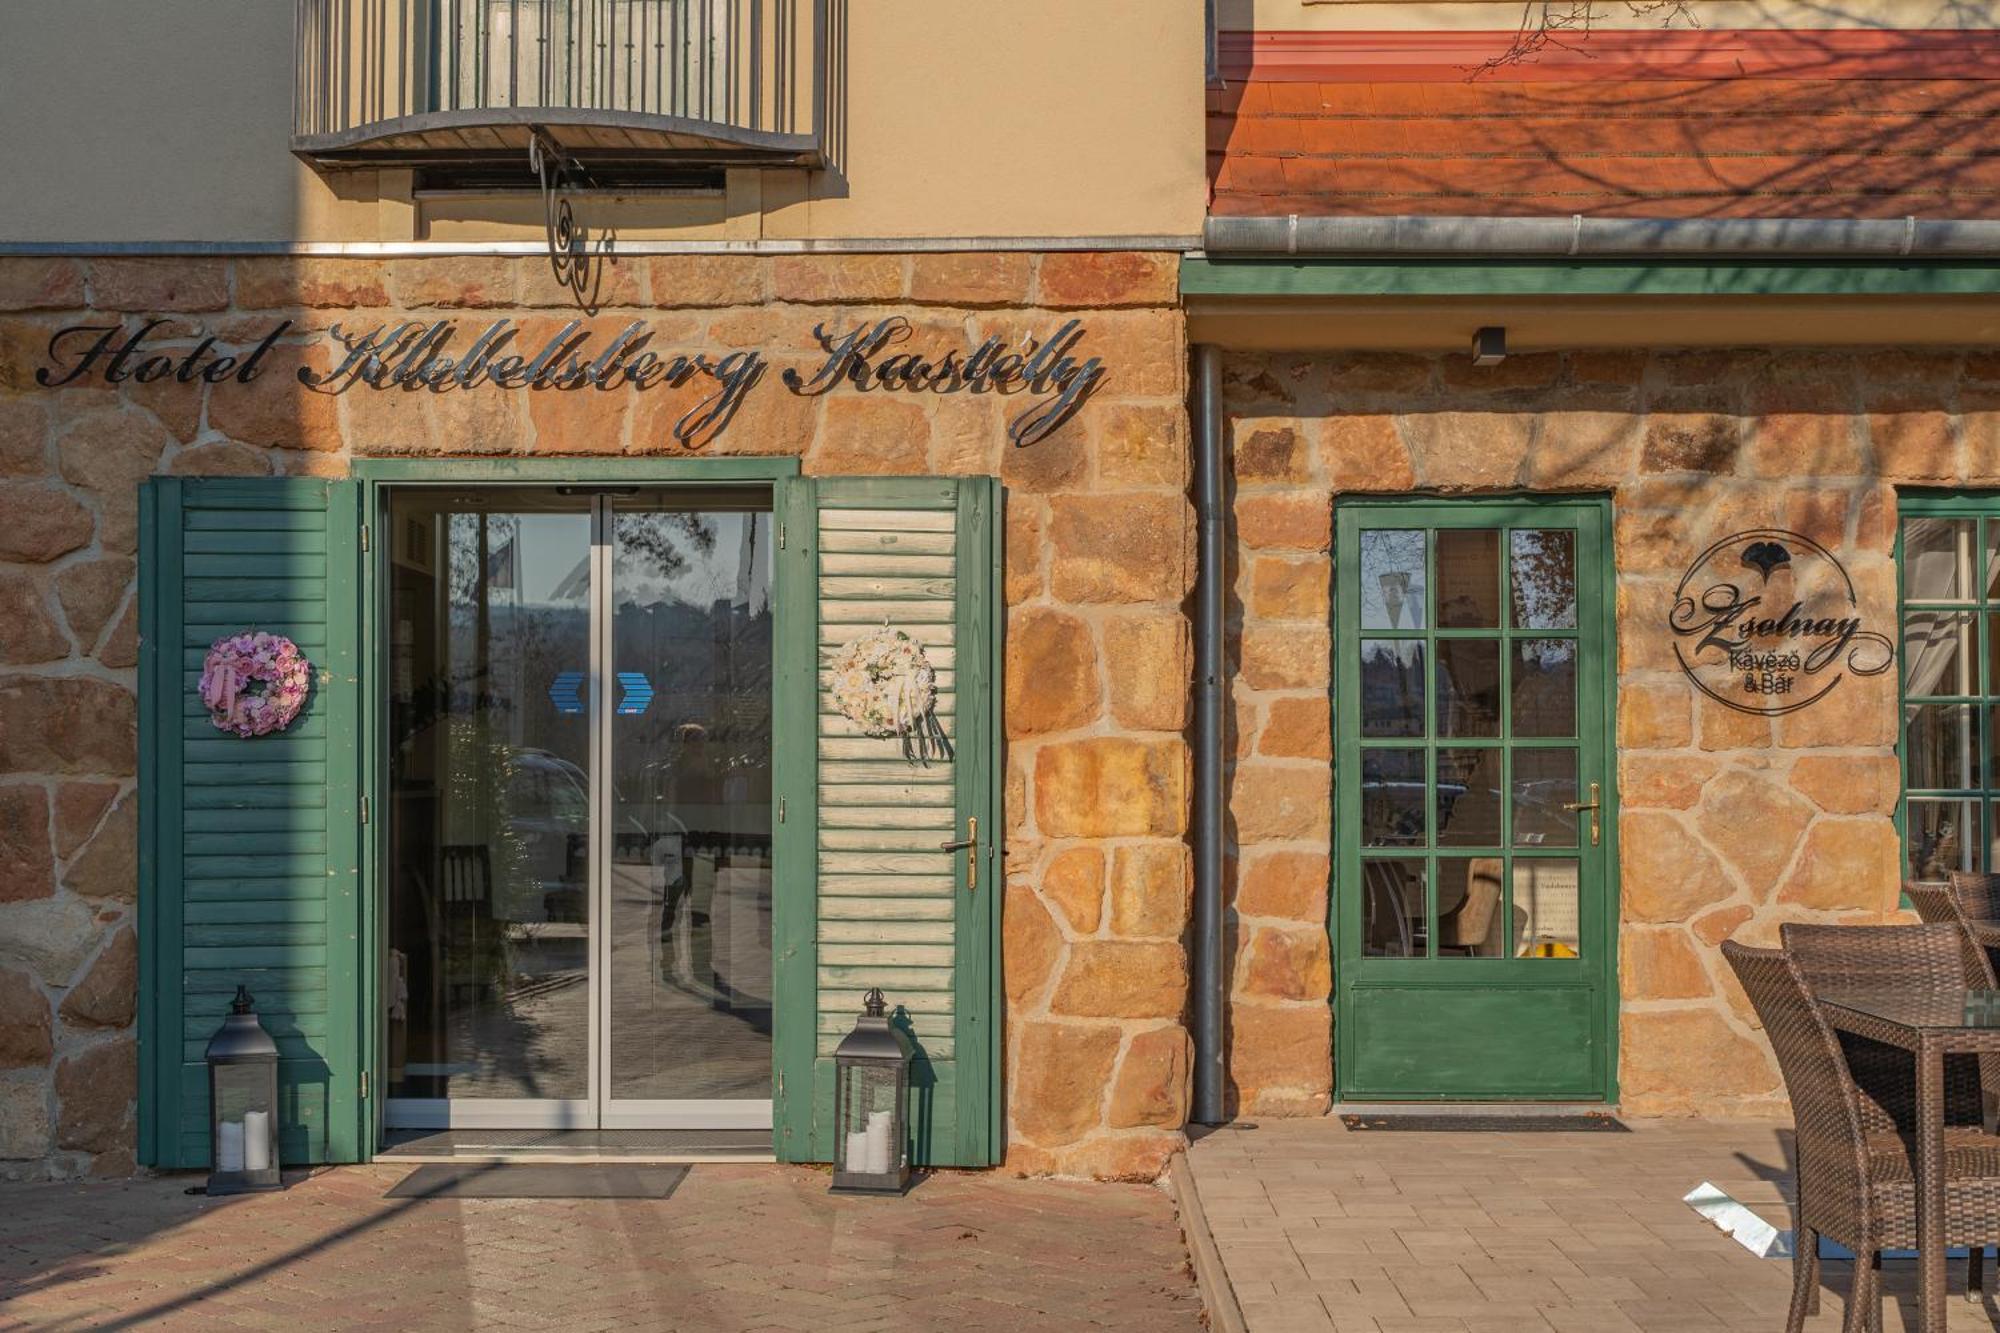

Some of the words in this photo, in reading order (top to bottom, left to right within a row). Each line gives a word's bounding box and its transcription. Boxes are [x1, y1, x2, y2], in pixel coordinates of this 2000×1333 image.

[36, 319, 295, 387] Hotel
[298, 319, 762, 446] Klebelsberg
[783, 316, 1101, 447] Kastély
[1669, 584, 1893, 675] Zsolnay
[1744, 673, 1757, 691] &
